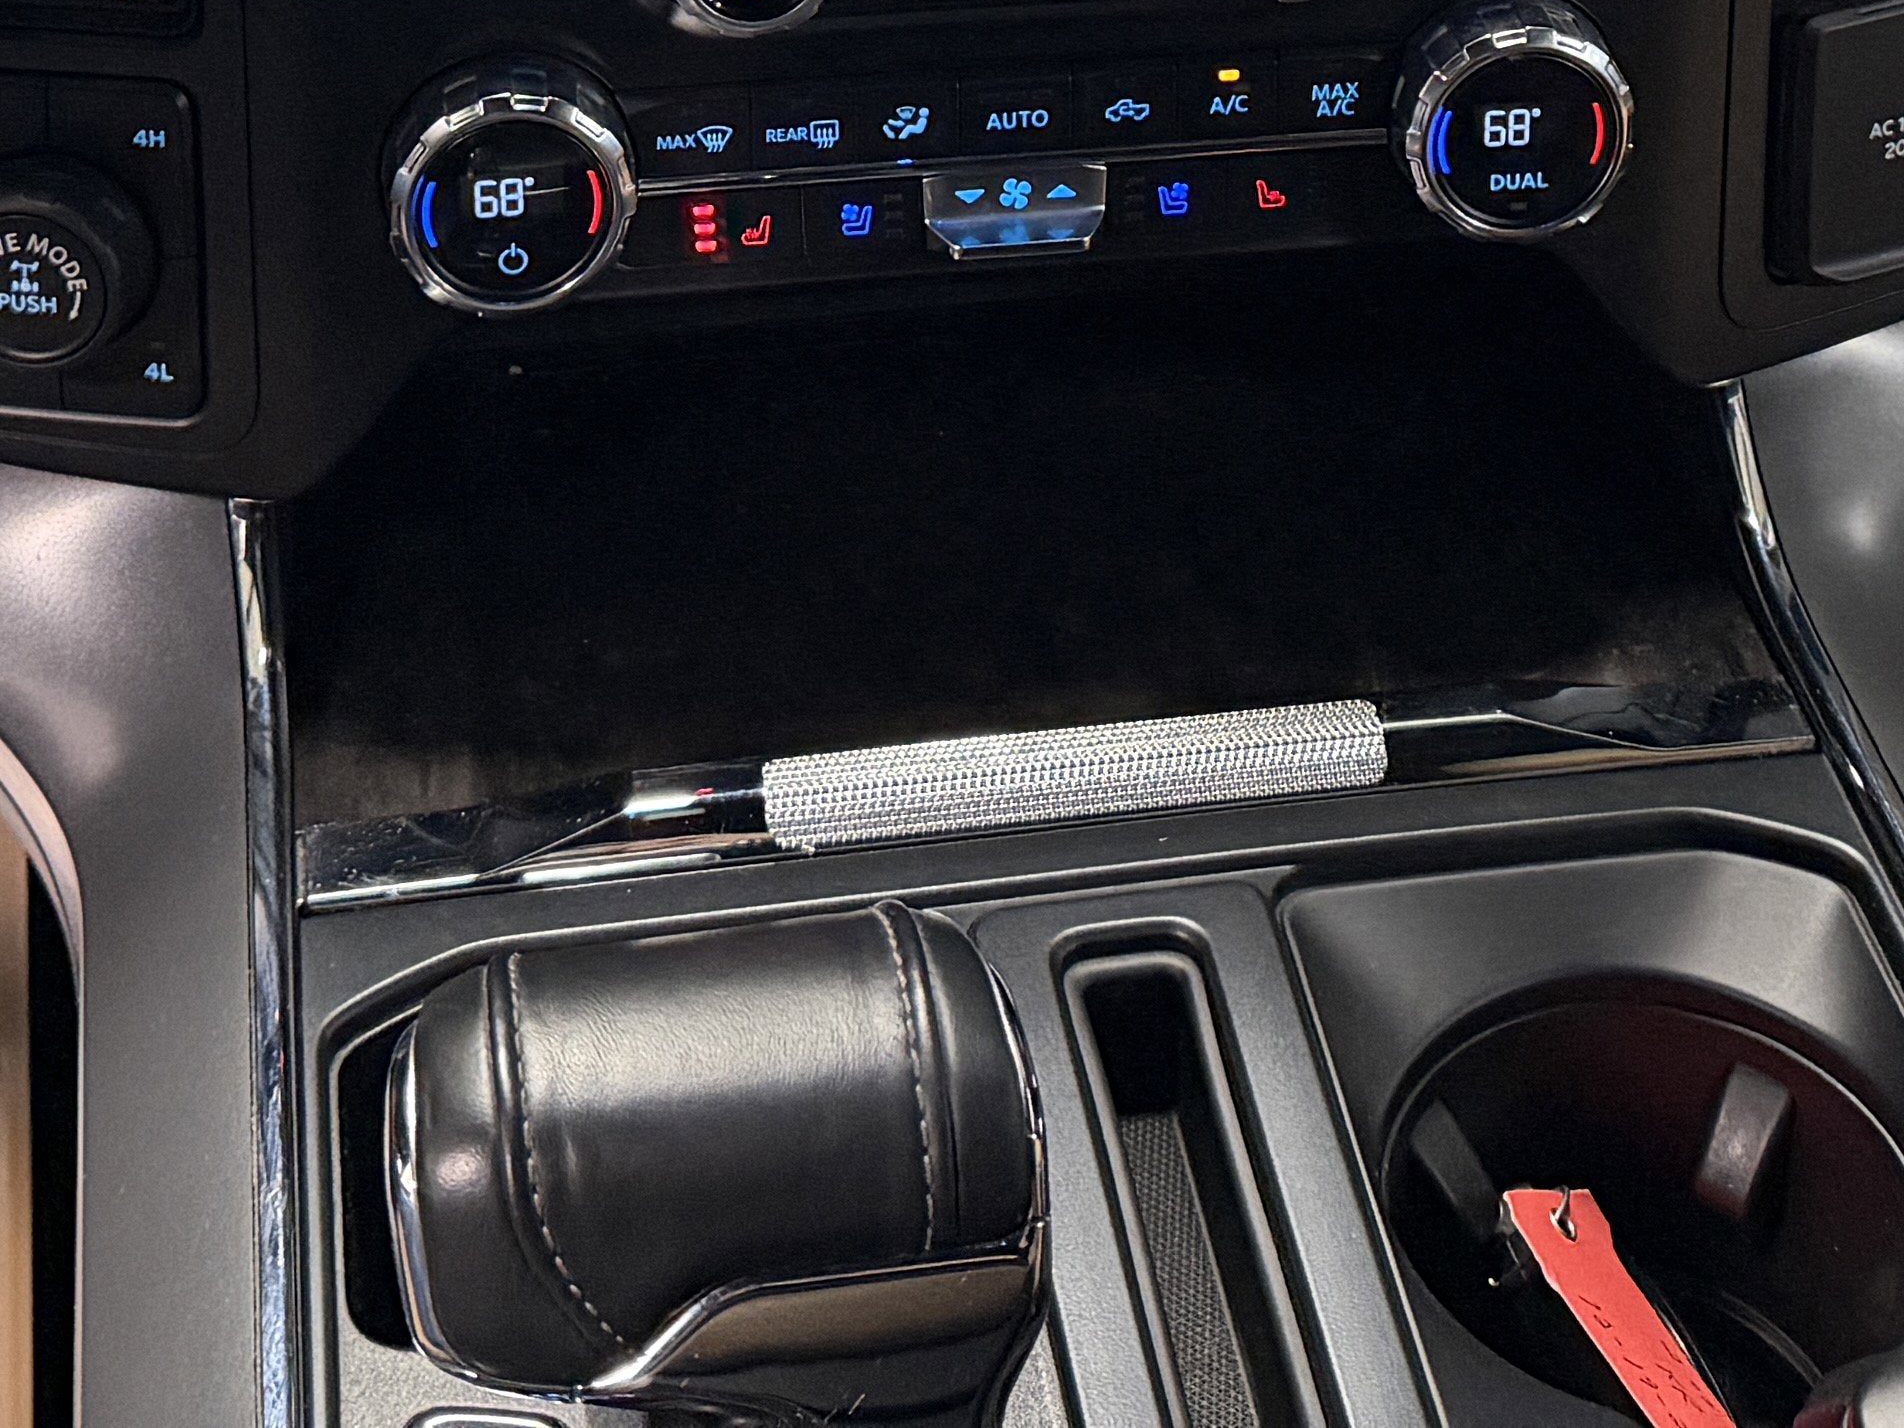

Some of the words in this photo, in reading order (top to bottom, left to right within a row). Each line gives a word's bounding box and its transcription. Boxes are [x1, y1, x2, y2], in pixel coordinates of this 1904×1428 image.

[1311, 81, 1360, 101] MAX
[1209, 93, 1249, 116] A/C
[1315, 96, 1356, 117] A/C
[985, 109, 1050, 131] AUTO
[1868, 118, 1895, 139] AC
[131, 129, 167, 149] 4H
[655, 134, 697, 151] MAX
[764, 127, 809, 144] REAR
[1488, 171, 1549, 192] DUAL
[25, 232, 89, 293] MODE
[143, 362, 174, 383] 4L
